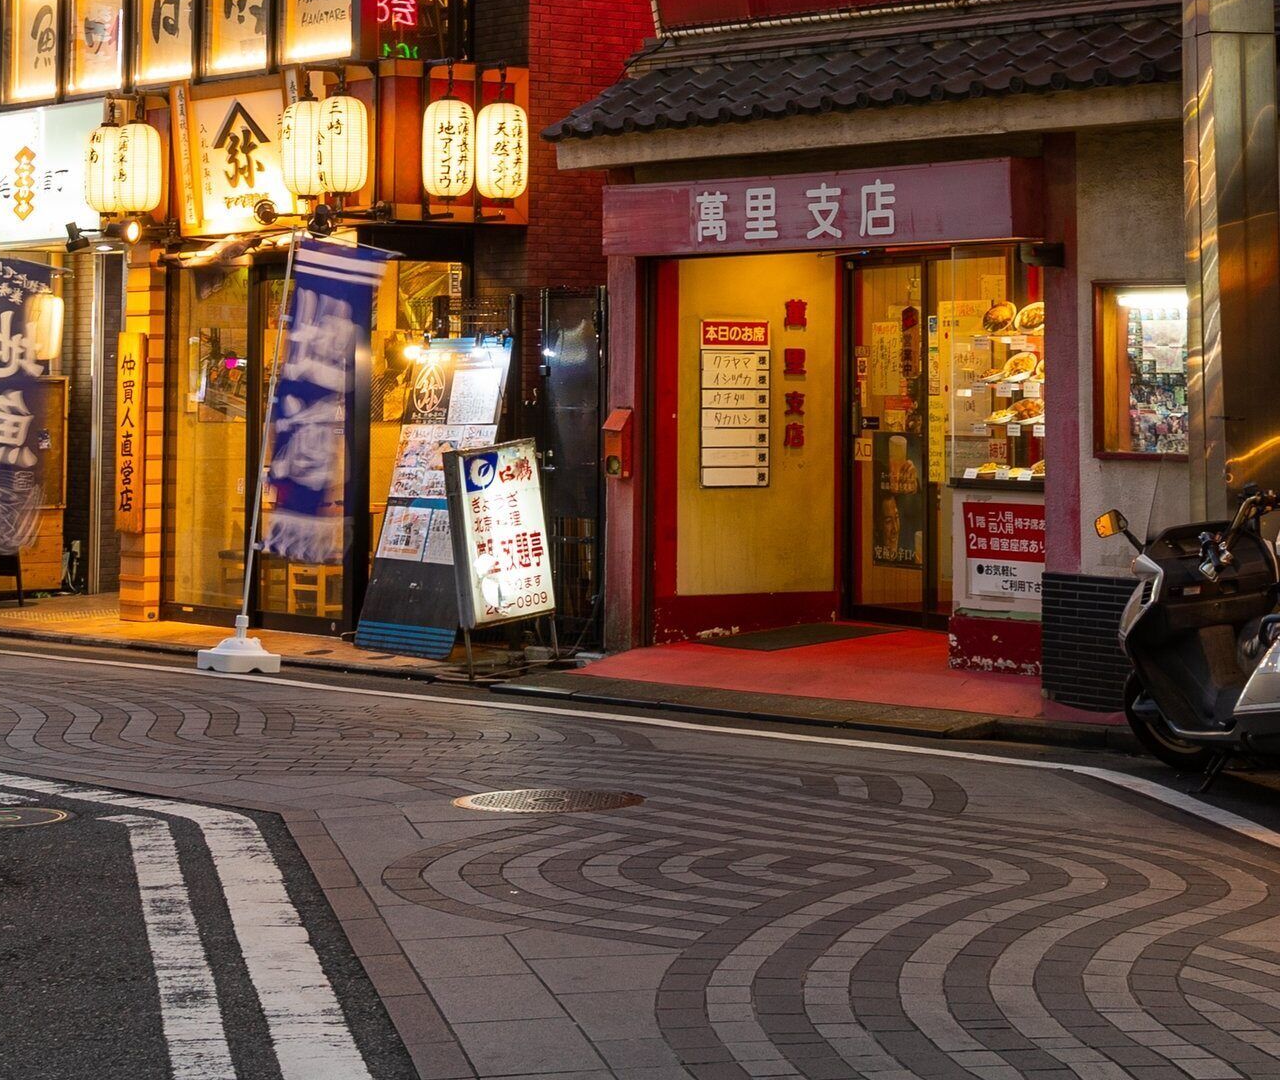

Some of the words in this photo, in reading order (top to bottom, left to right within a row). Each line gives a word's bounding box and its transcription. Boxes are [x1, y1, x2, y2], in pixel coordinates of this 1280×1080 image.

[437, 121, 456, 189] 地アンコウ
[493, 122, 511, 191] 天然ふぐ
[696, 179, 896, 242] 萬里支店
[705, 326, 766, 342] 本日のお席
[783, 299, 808, 448] 萬里支店
[118, 353, 136, 512] 仲買人直営店
[967, 511, 986, 528] 1階
[969, 533, 987, 549] 2階
